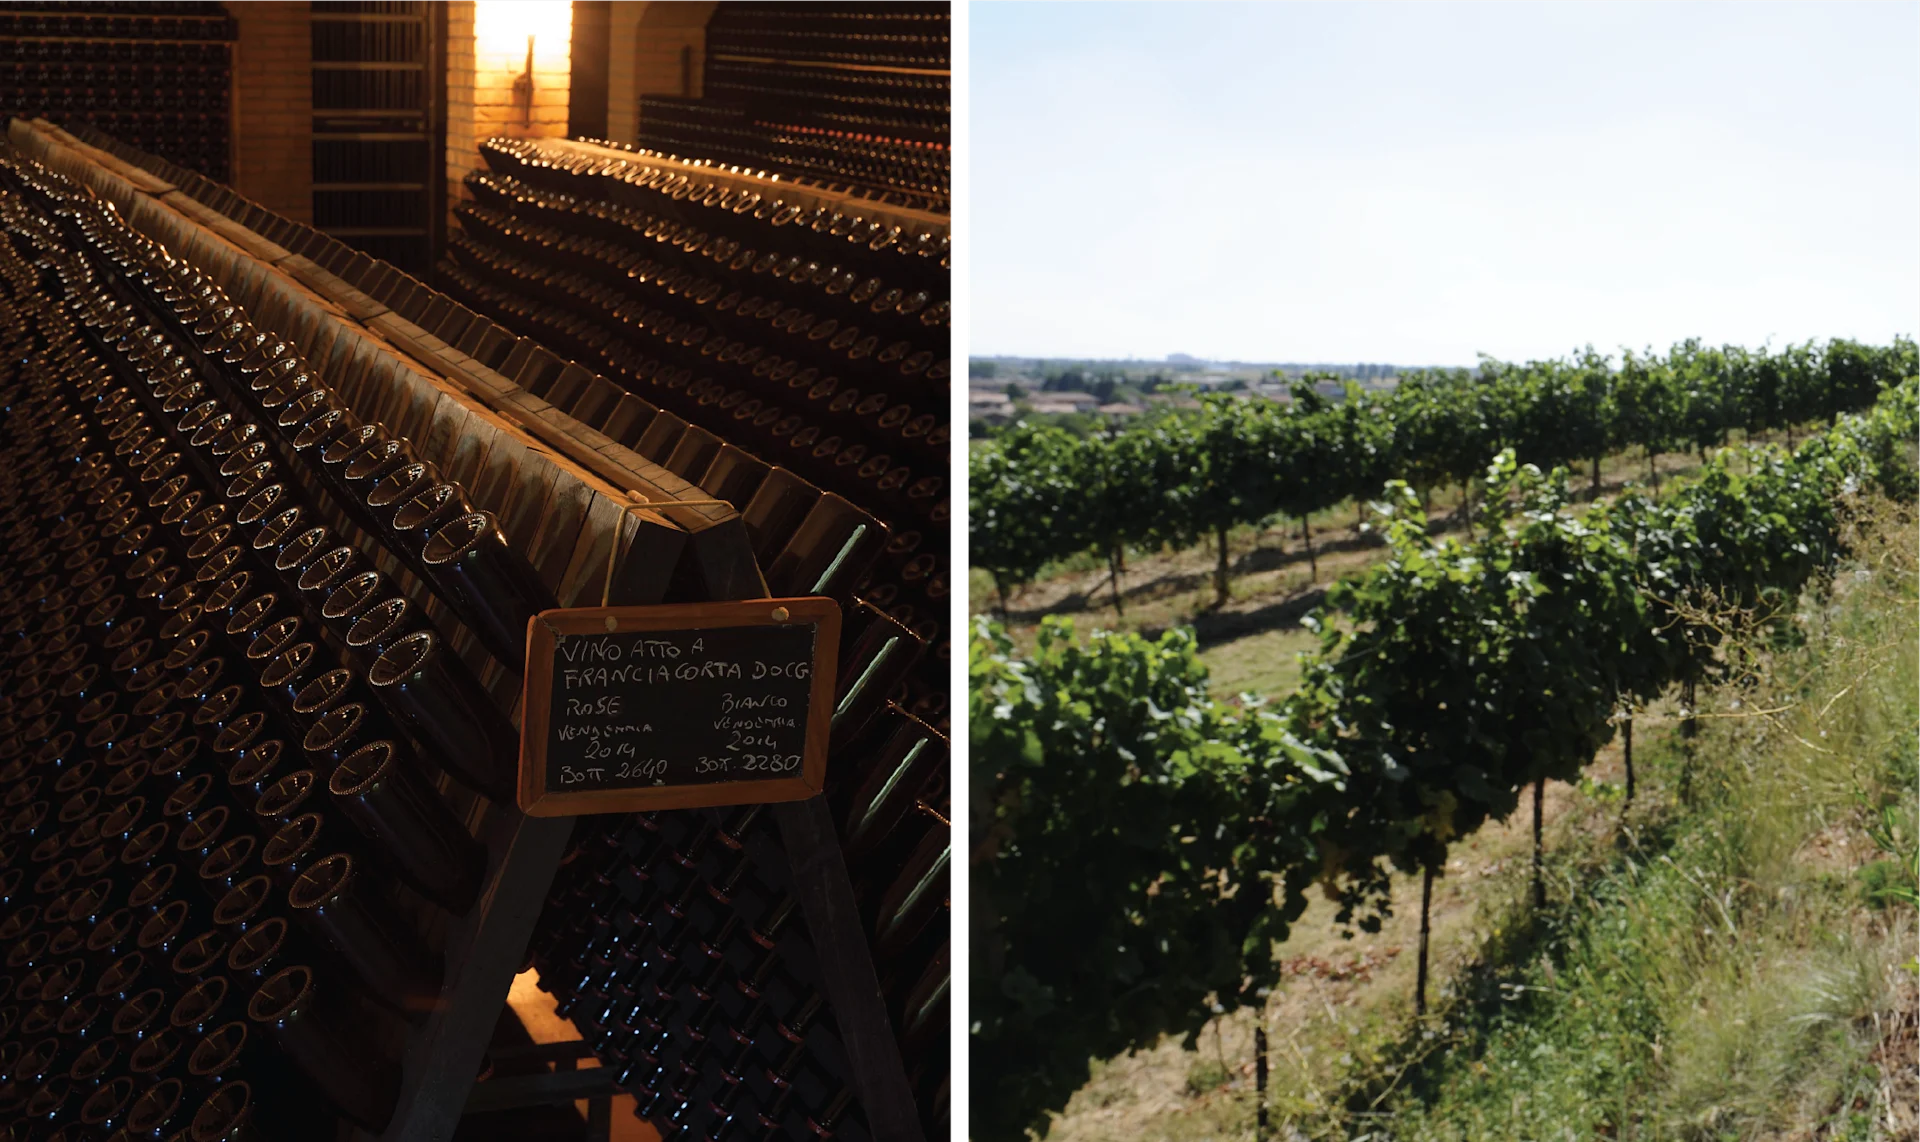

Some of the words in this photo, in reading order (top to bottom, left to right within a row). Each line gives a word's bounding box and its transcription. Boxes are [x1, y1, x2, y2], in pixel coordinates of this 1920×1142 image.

[562, 636, 621, 662] VINO
[631, 640, 681, 658] ATTO
[692, 638, 704, 655] A
[564, 661, 742, 689] FRANCIACORTA
[566, 696, 621, 716] ROSE
[722, 693, 788, 713] BIANCO
[584, 738, 636, 759] 2014
[726, 731, 777, 751] 2014
[616, 759, 668, 779] 2640
[742, 754, 801, 772] 2280
